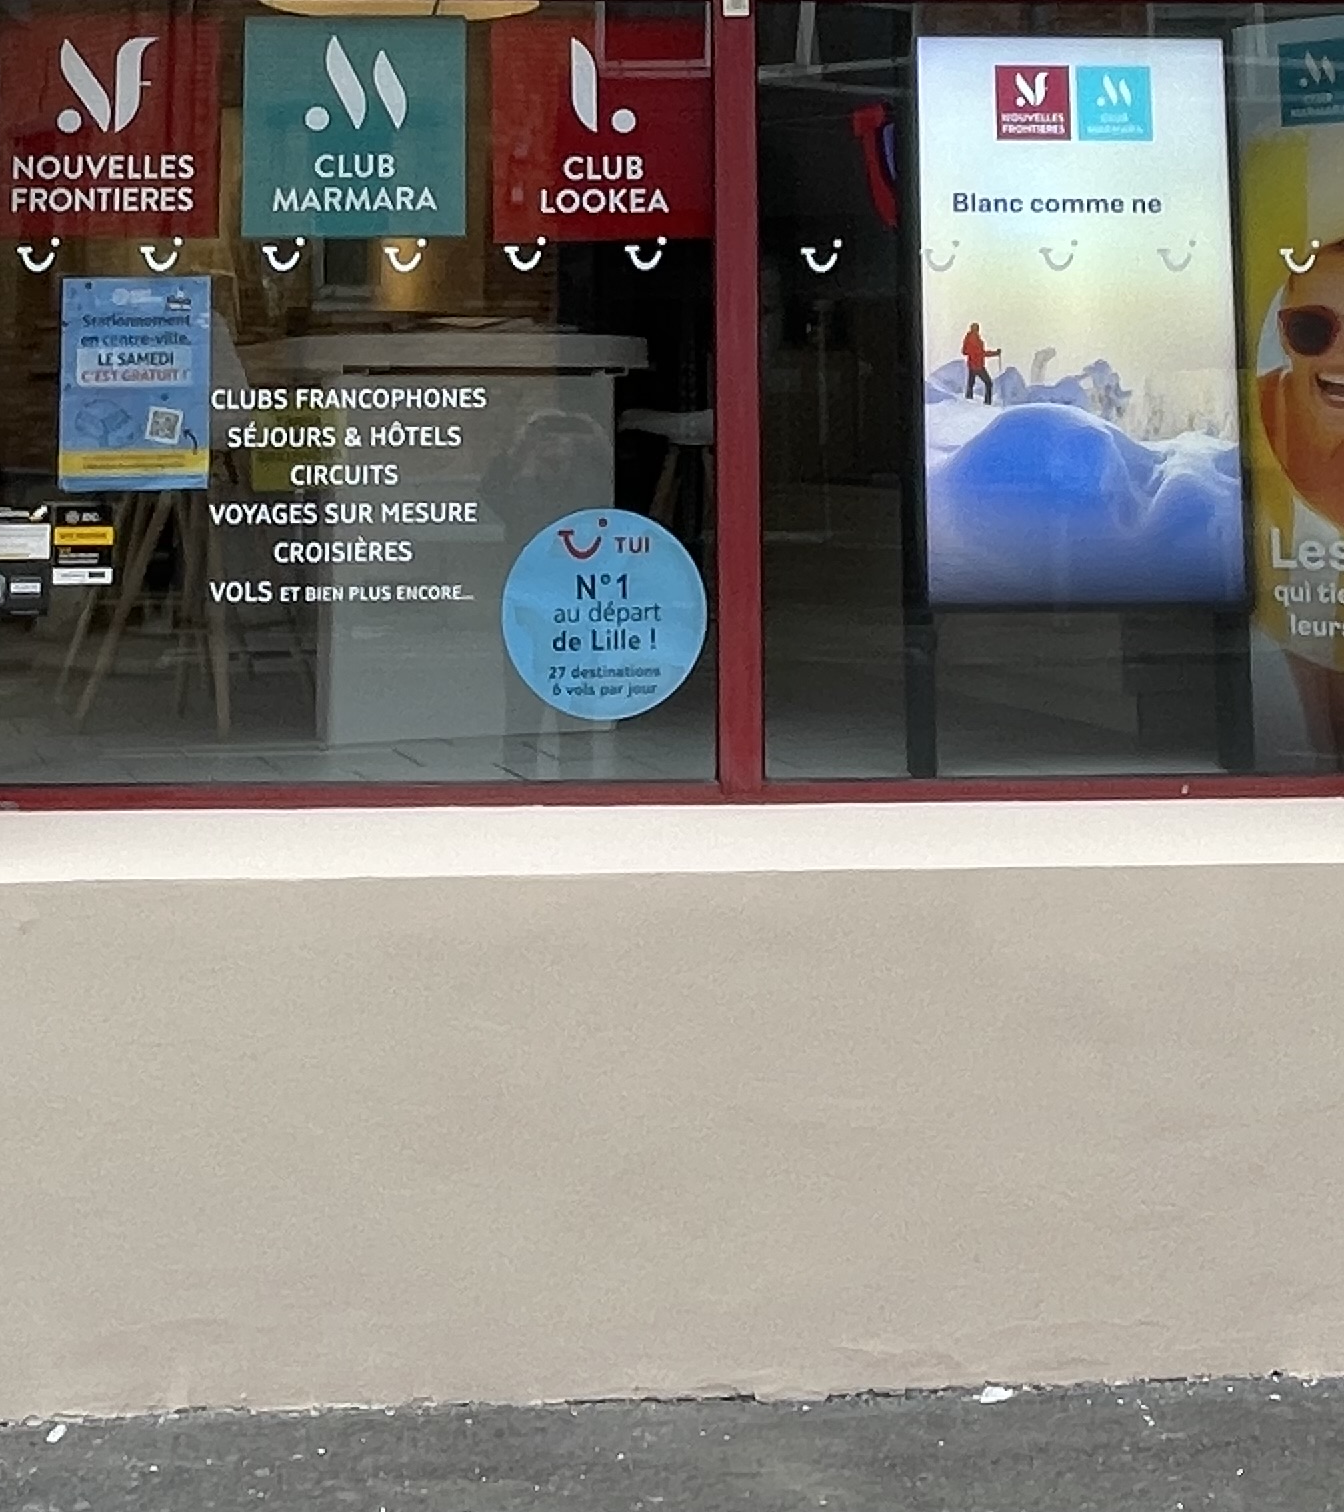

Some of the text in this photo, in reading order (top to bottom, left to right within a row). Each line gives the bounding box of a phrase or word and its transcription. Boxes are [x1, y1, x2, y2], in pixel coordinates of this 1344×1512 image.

[12, 153, 195, 180] NOUVELLES
[314, 153, 396, 179] CLUB
[563, 155, 645, 181] CLUB
[11, 186, 194, 213] FRONTIERES
[272, 186, 438, 213] MARMARA
[540, 187, 669, 214] LOOKEA
[952, 192, 1162, 214] Blanc comme ne
[98, 351, 174, 366] LE SAMEDI
[80, 369, 117, 383] C'EST
[118, 369, 178, 382] GRATUIT
[211, 387, 487, 410] CLUBS FRANCOPHONES
[227, 420, 462, 448] SÉJOURS & HÔTELS
[290, 464, 399, 486] CIRCUITS
[209, 502, 478, 525] VOYAGES SUR MESURE
[273, 535, 413, 564] CROISIÈRES
[614, 536, 650, 554] TUI
[209, 581, 273, 602] VOLS
[280, 586, 301, 602] ET
[305, 586, 344, 602] BIEN
[348, 585, 391, 601] PLUS
[1274, 581, 1312, 607] qui
[553, 600, 662, 627] au départ
[552, 628, 657, 652] de Lille !
[548, 664, 661, 680] 27 destinations
[600, 685, 624, 697] par
[626, 682, 658, 698] jour
